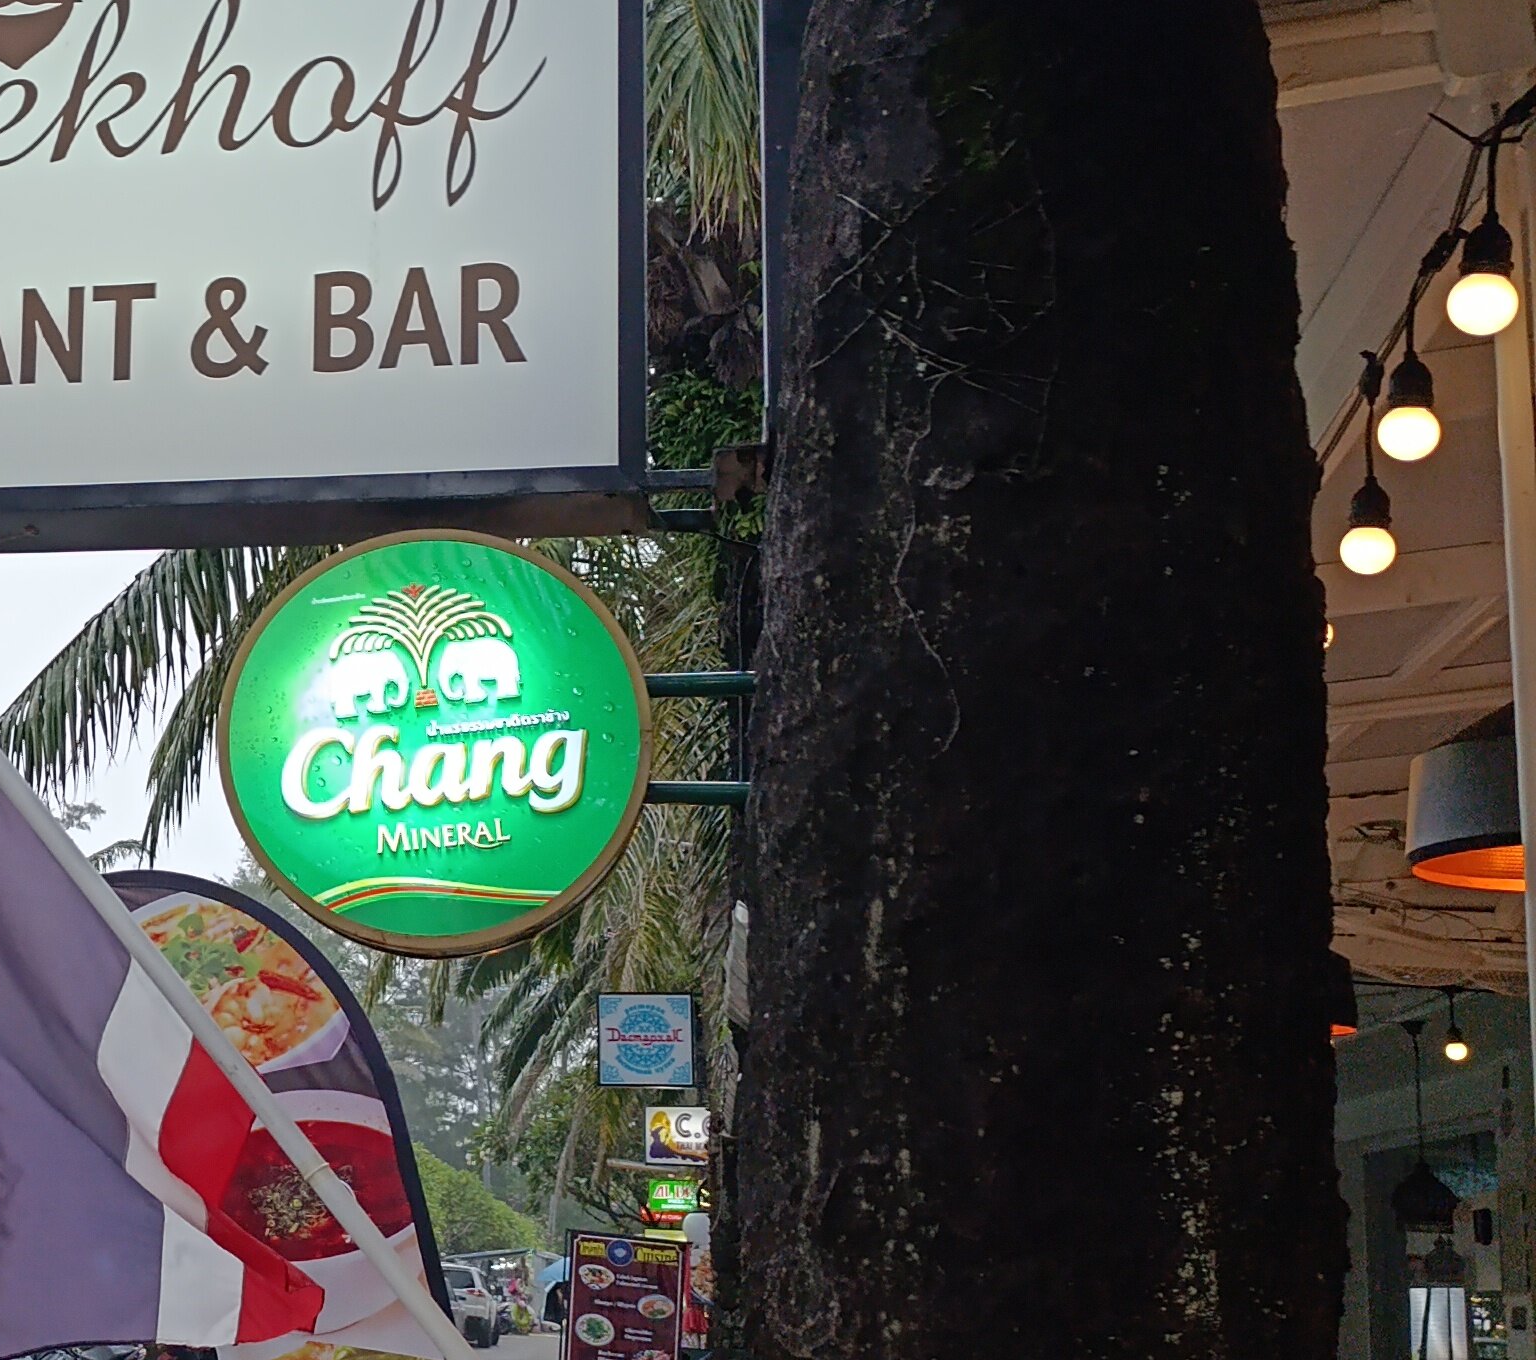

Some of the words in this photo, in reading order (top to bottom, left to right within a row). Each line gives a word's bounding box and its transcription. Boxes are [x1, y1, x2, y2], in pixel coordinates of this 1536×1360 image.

[190, 276, 270, 378] &
[312, 262, 528, 375] BAR
[280, 725, 589, 820] Chang
